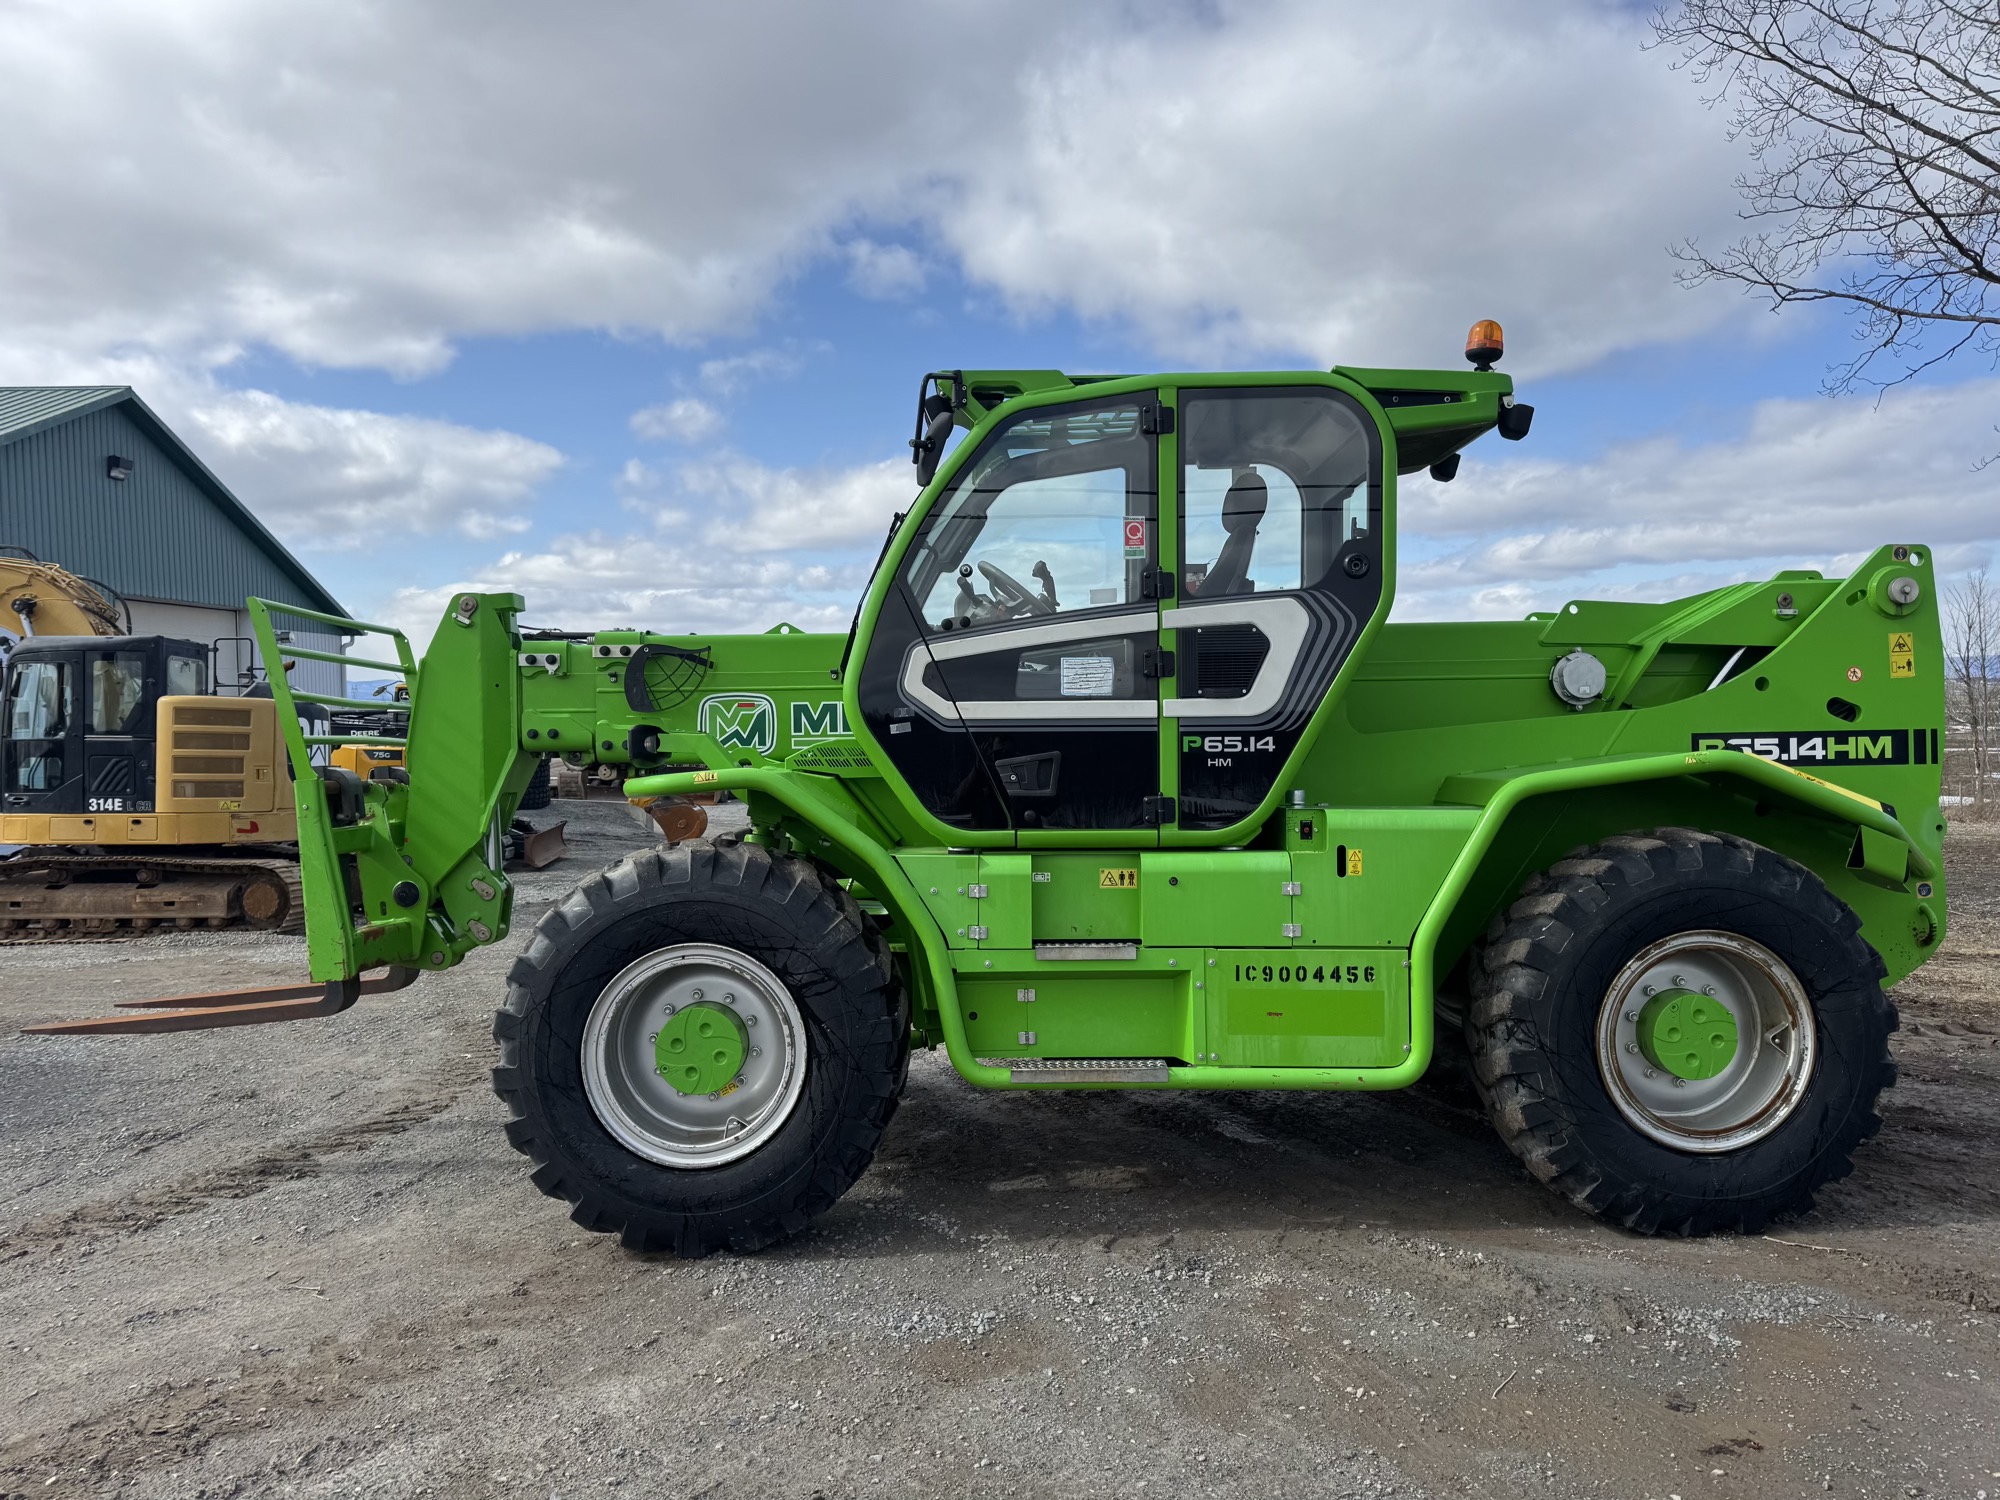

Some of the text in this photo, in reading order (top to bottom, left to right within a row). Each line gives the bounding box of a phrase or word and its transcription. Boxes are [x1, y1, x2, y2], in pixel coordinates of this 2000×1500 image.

[350, 729, 381, 737] DEERE
[1182, 735, 1276, 753] P65.14
[373, 751, 391, 759] 75G
[1207, 758, 1232, 767] HM
[88, 797, 152, 812] 314E L CR
